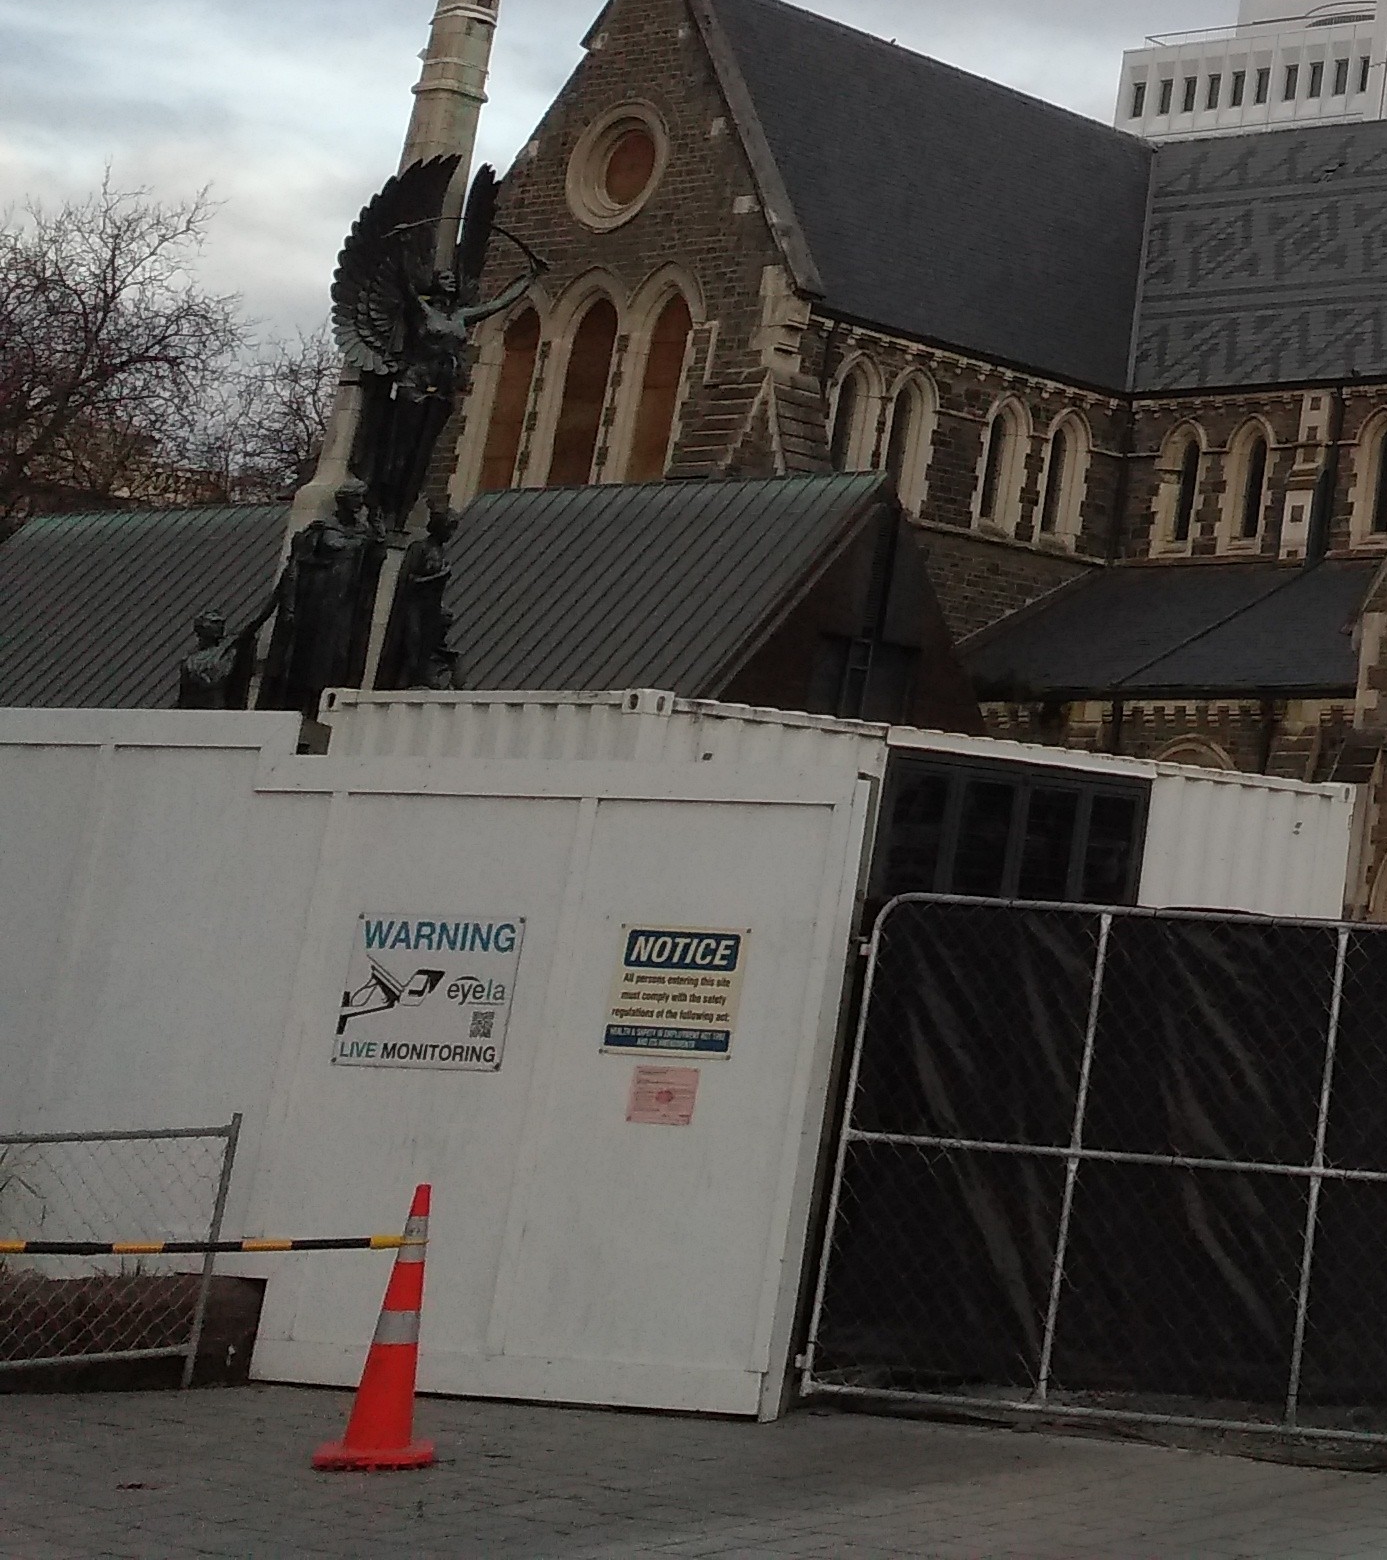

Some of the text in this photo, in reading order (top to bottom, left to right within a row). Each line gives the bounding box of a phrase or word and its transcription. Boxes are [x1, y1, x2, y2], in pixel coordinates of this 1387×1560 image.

[364, 920, 517, 954] WARNING
[629, 935, 735, 966] NOTICE
[446, 976, 506, 1006] eyela
[622, 972, 731, 988] All persons entering this site
[620, 991, 727, 1006] must comply with the safety
[611, 1007, 655, 1019] regulations
[655, 1008, 664, 1019] of
[664, 1009, 678, 1019] the
[679, 1010, 714, 1024] following
[339, 1041, 496, 1063] LIVE MONITORING
